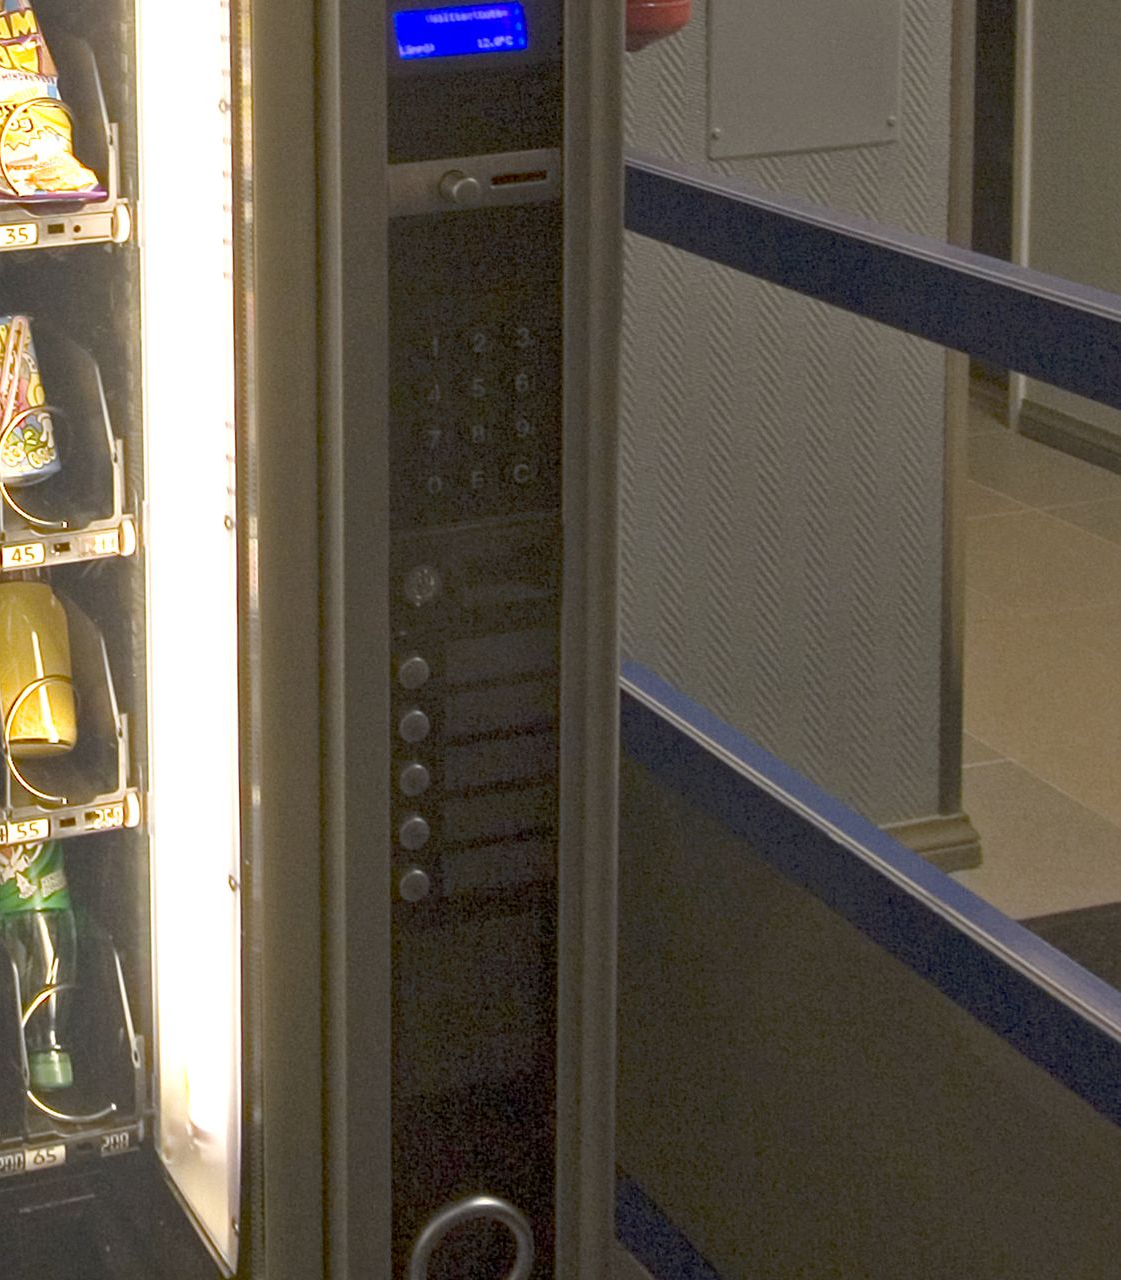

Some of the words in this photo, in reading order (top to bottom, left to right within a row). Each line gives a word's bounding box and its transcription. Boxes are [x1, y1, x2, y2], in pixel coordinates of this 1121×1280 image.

[5, 227, 29, 244] 35
[11, 546, 35, 562] 45
[16, 822, 39, 838] 55
[33, 1149, 57, 1165] 65
